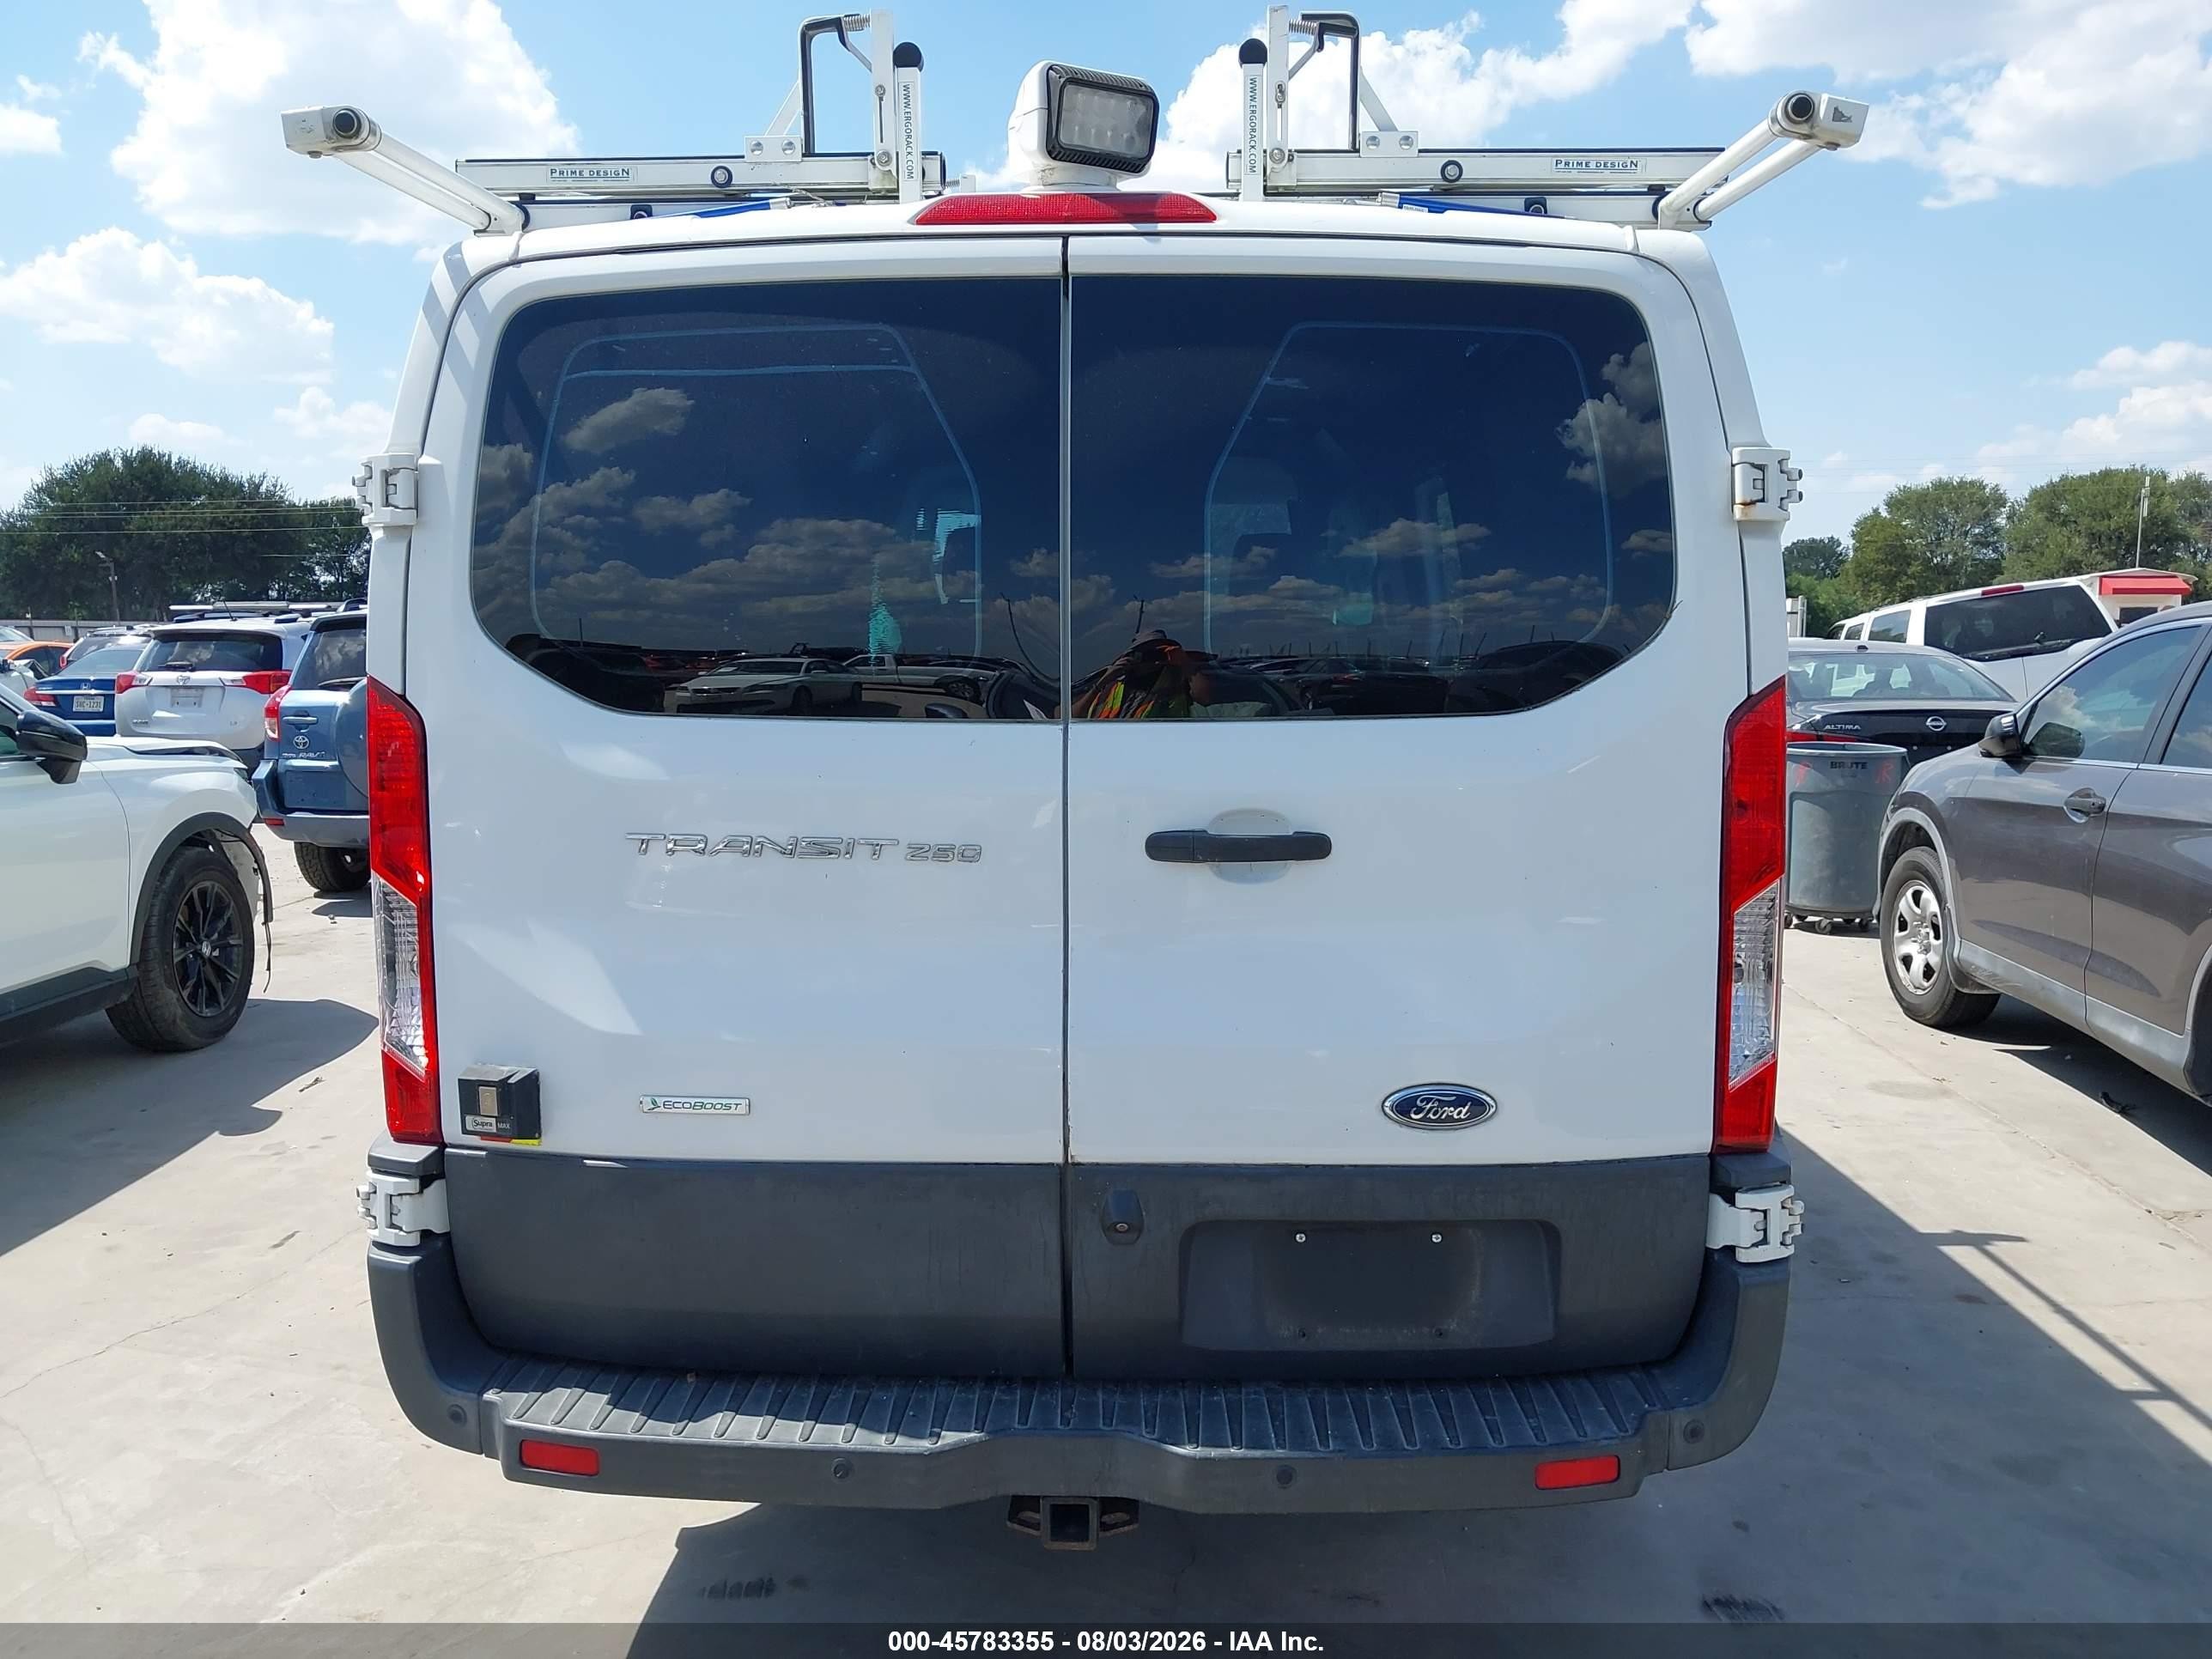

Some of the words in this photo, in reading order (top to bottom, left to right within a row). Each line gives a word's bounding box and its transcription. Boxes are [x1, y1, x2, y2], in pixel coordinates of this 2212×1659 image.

[902, 83, 915, 179] WWW.ERGORACK.COM
[1249, 76, 1258, 173] WWW.ERGORACK.COM
[1830, 761, 1869, 770] BRUTE
[625, 832, 899, 860] TRANSIT
[904, 843, 982, 863] 250
[662, 1100, 742, 1111] ECOBOOST
[1409, 1095, 1473, 1120] Ford
[473, 1119, 493, 1128] Supra
